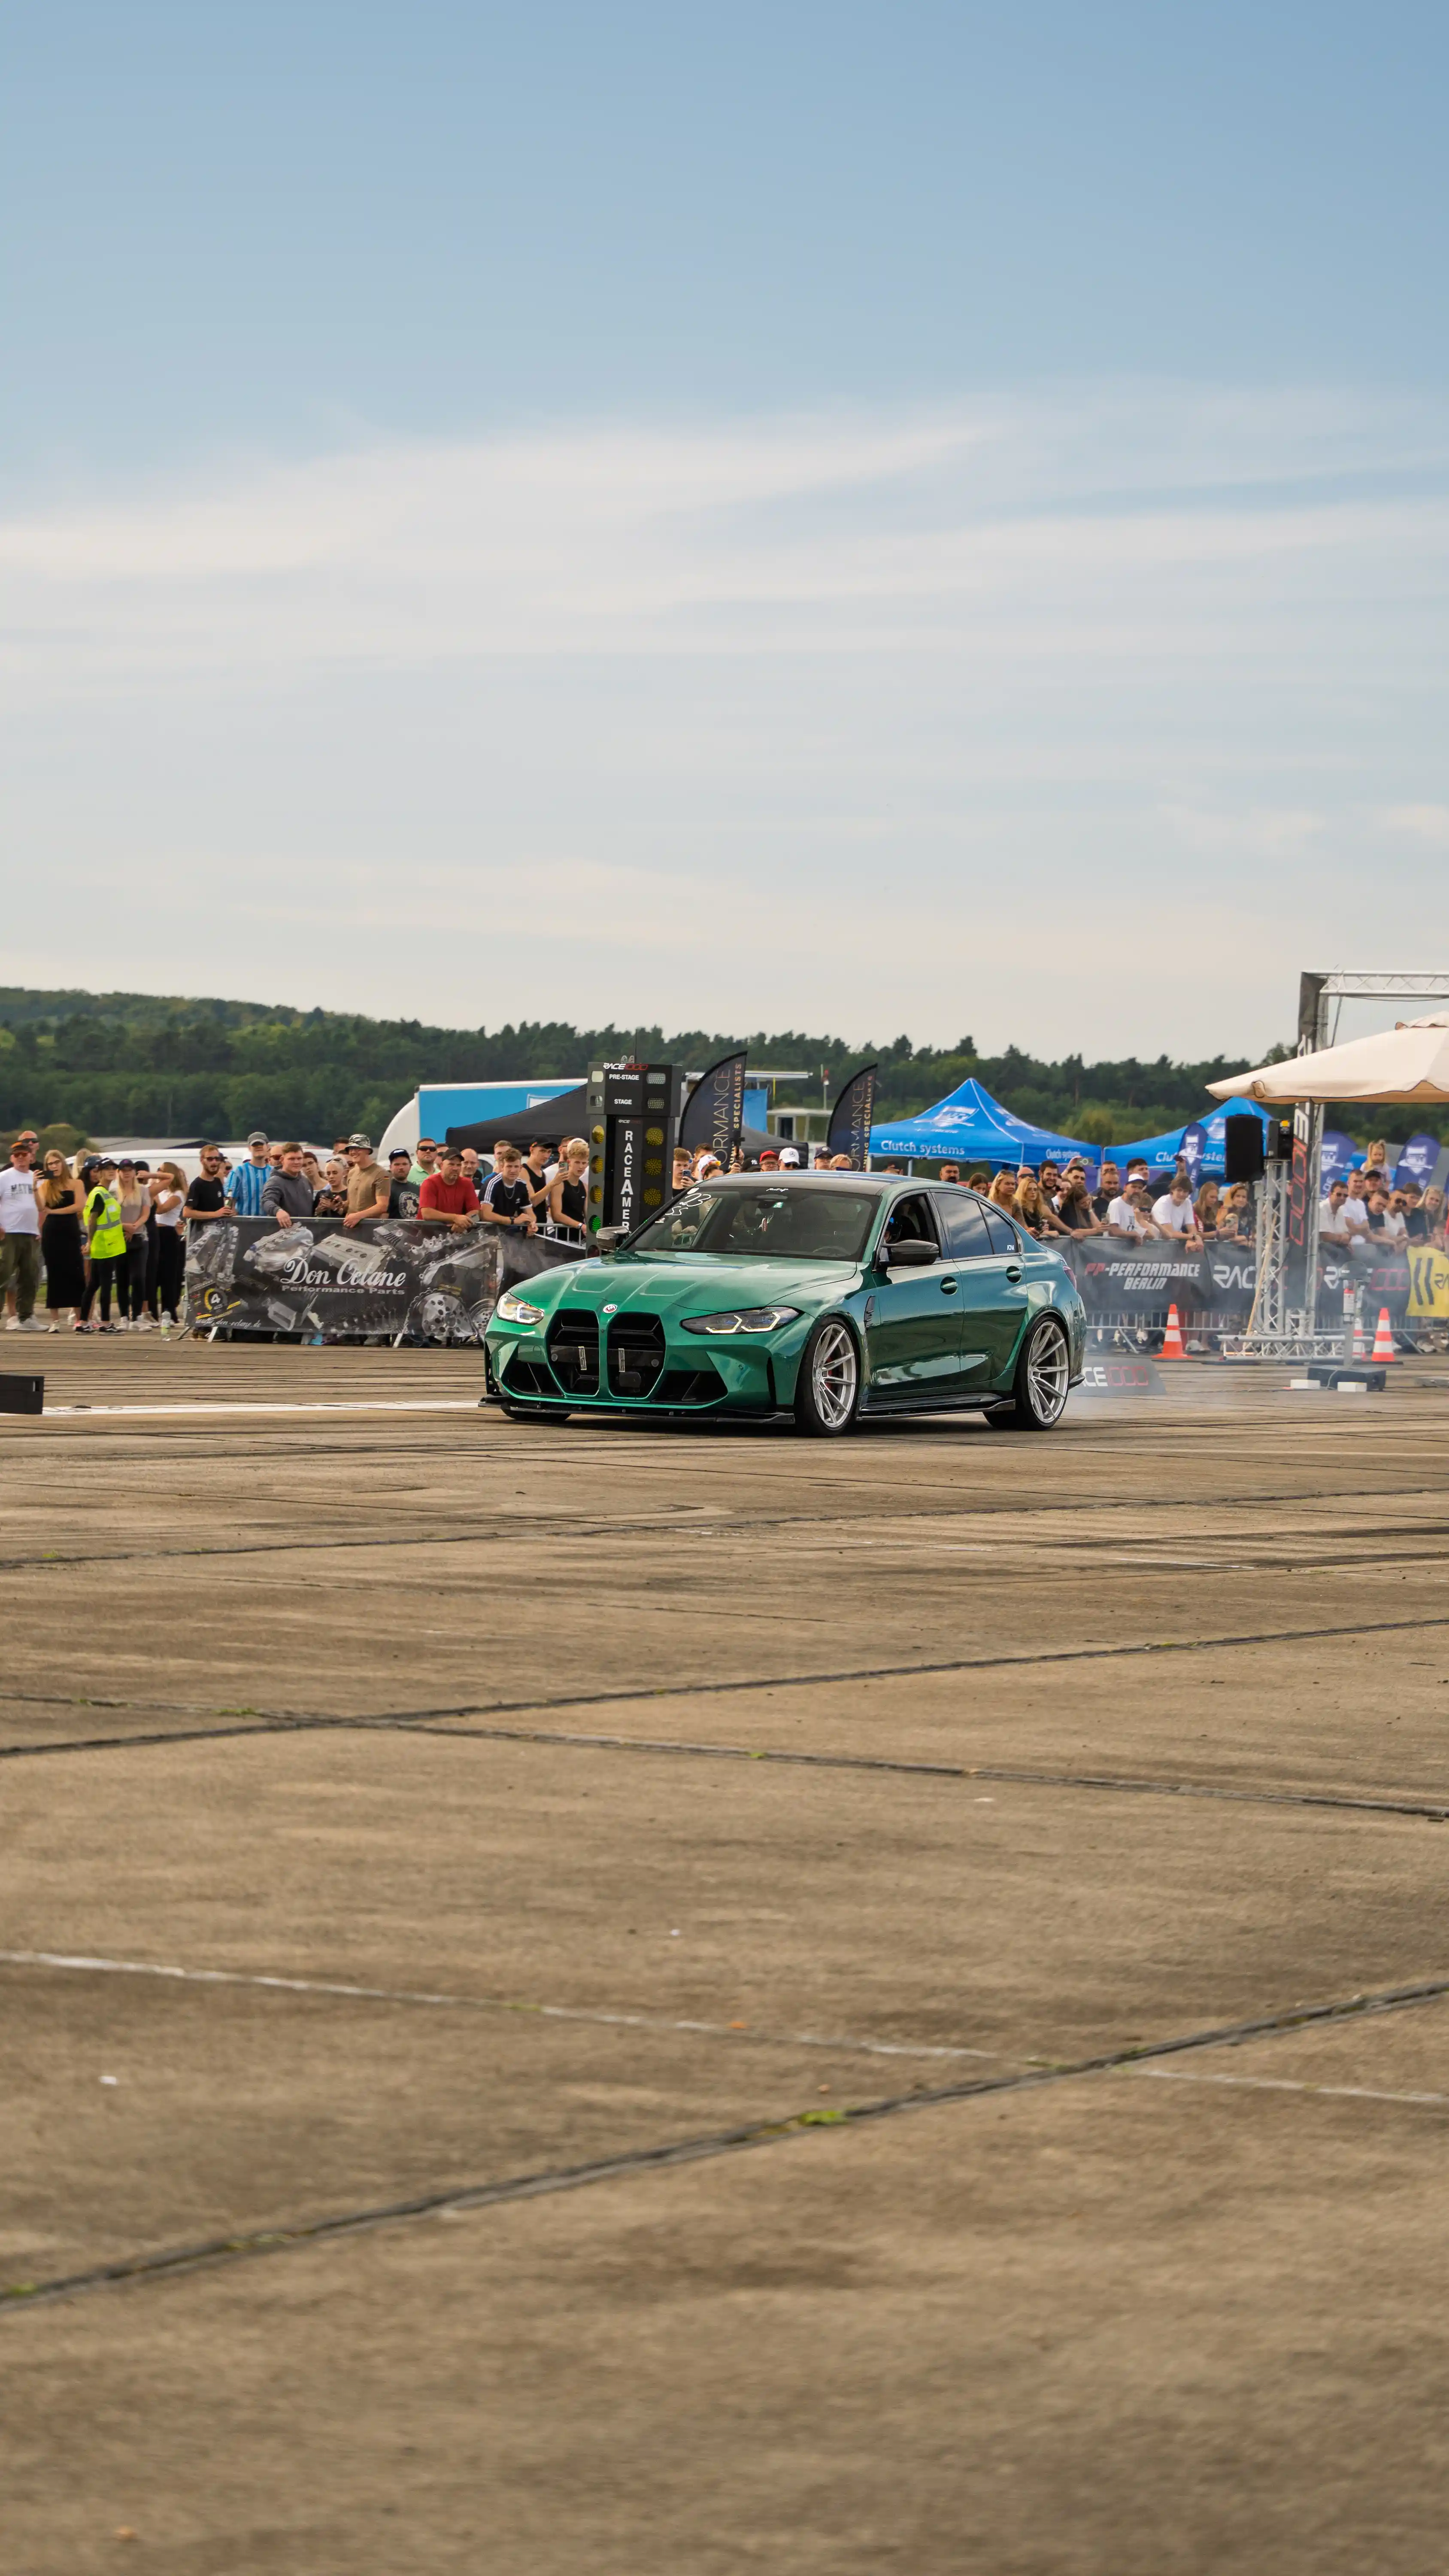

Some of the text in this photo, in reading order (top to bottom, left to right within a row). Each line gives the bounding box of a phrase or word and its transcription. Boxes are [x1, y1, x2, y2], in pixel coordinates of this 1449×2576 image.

[733, 1063, 742, 1129] SPECIALISTS
[881, 1140, 965, 1156] Clutch systems
[280, 1256, 406, 1287] Don Octane
[282, 1285, 364, 1294] Performance
[1123, 1277, 1167, 1290] BERLIN
[211, 1293, 221, 1304] 4
[1082, 1366, 1149, 1387] CE1000
